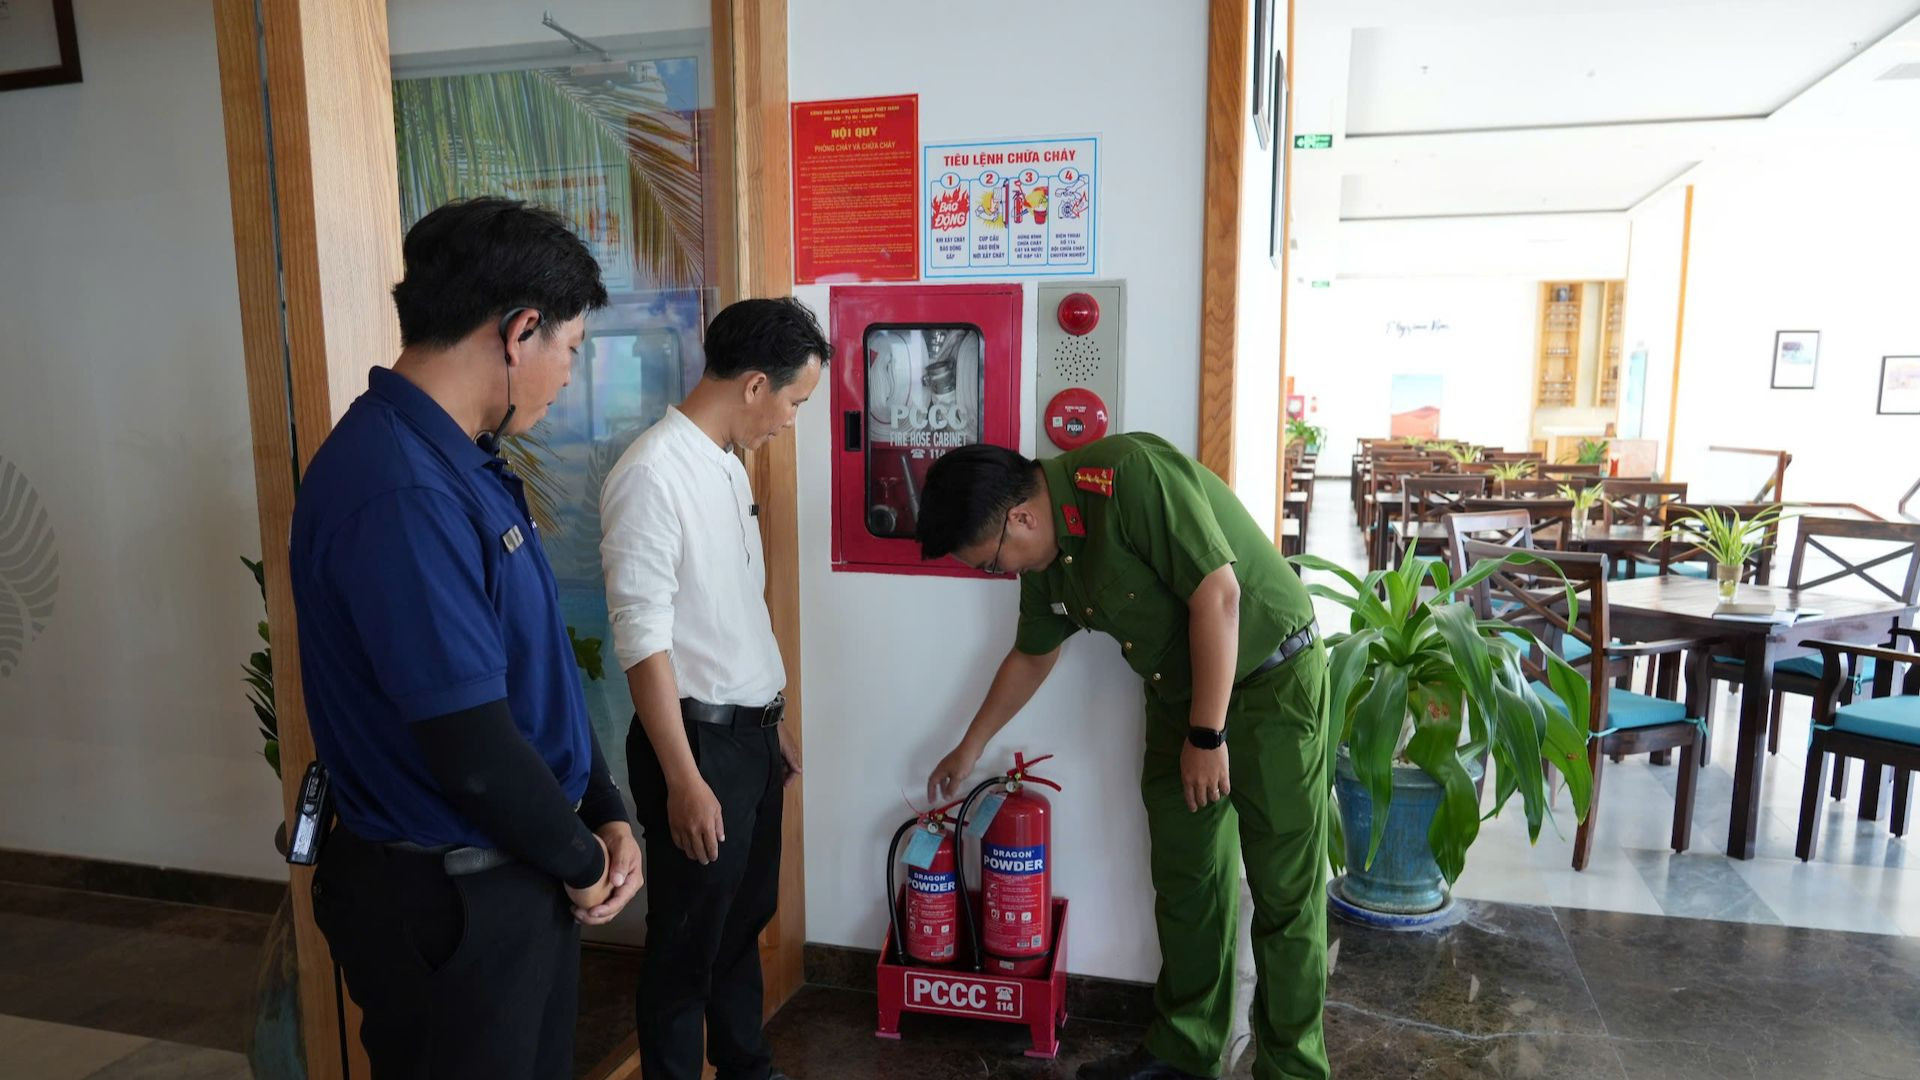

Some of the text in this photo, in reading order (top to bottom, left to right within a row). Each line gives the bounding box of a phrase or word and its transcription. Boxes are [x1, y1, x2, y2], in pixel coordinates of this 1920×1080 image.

[831, 127, 877, 139] NỘI QUY
[944, 148, 1075, 167] TIÊU LỆNH CHỮA CHÁY
[947, 175, 953, 186] 1
[986, 173, 993, 184] 2
[1025, 172, 1033, 182] 3
[1065, 170, 1073, 180] 4
[890, 404, 968, 430] PCCC
[890, 431, 967, 447] FIRE HOSE CABINET
[993, 849, 1032, 858] DRAGON
[984, 854, 1043, 872] POWDER
[914, 872, 946, 881] DRAGON
[913, 978, 987, 1009] PCCC
[996, 1001, 1013, 1012] 114
